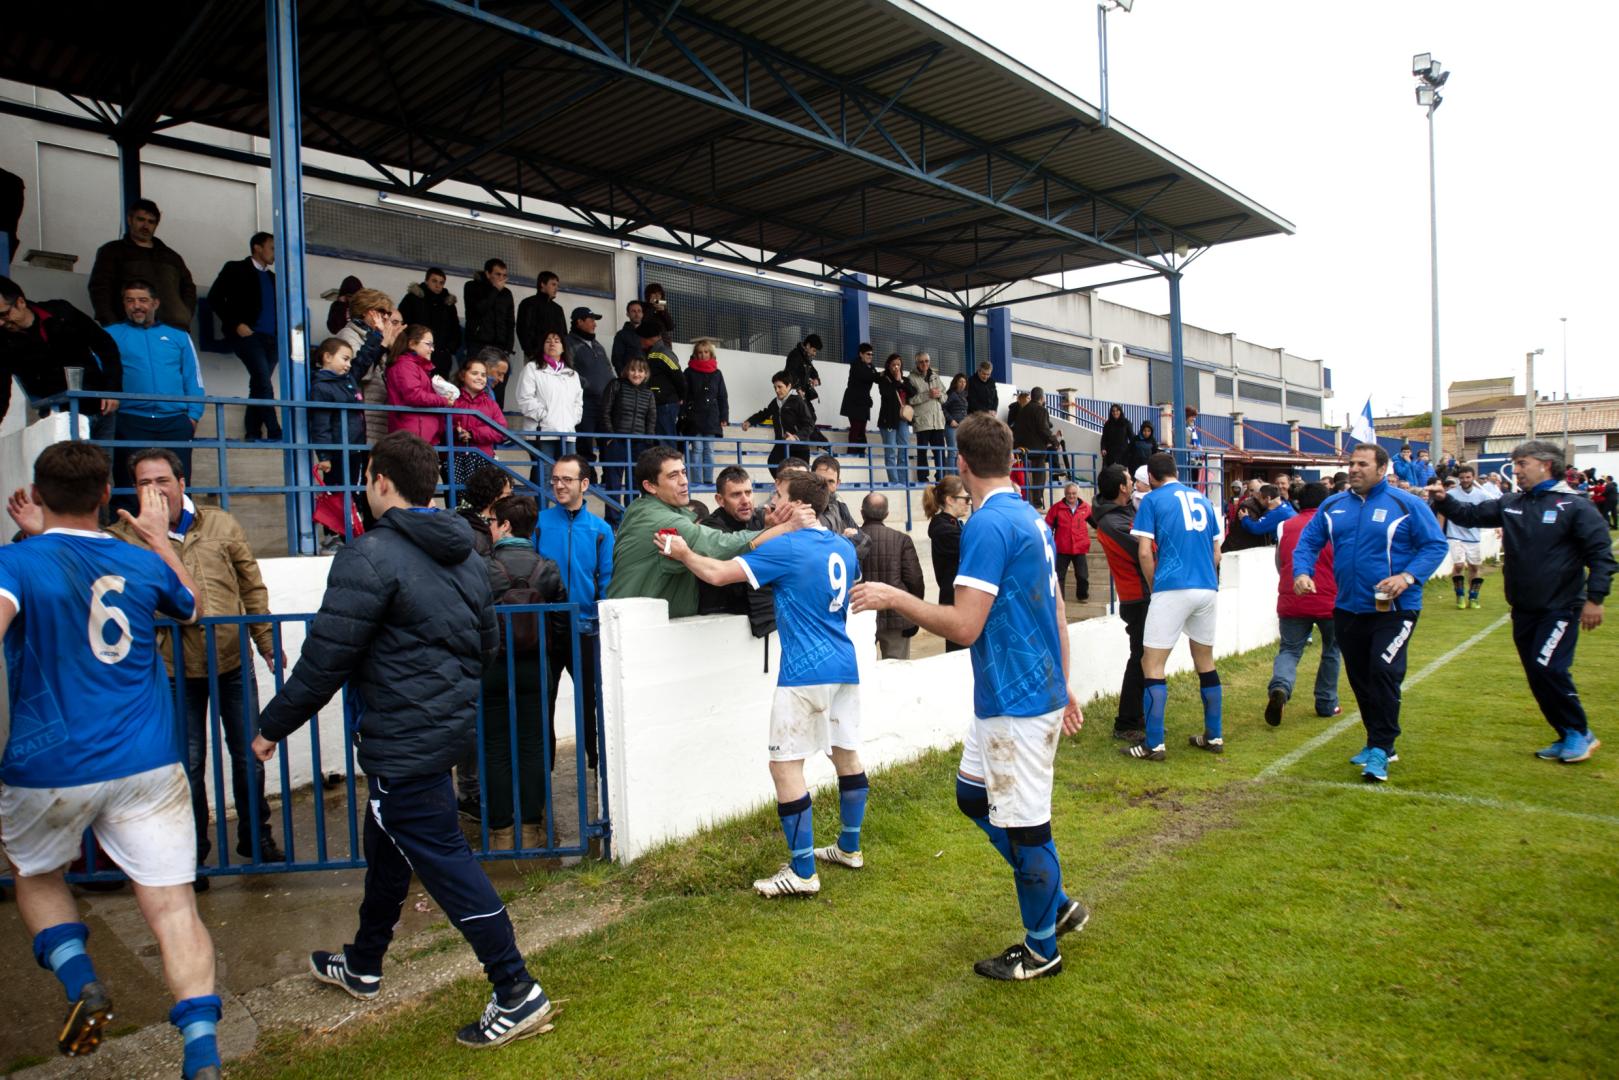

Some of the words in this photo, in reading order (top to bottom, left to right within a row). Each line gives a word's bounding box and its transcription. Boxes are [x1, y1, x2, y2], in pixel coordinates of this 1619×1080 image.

[1174, 490, 1208, 532] 15
[828, 552, 847, 613] 9
[88, 575, 134, 664] 6
